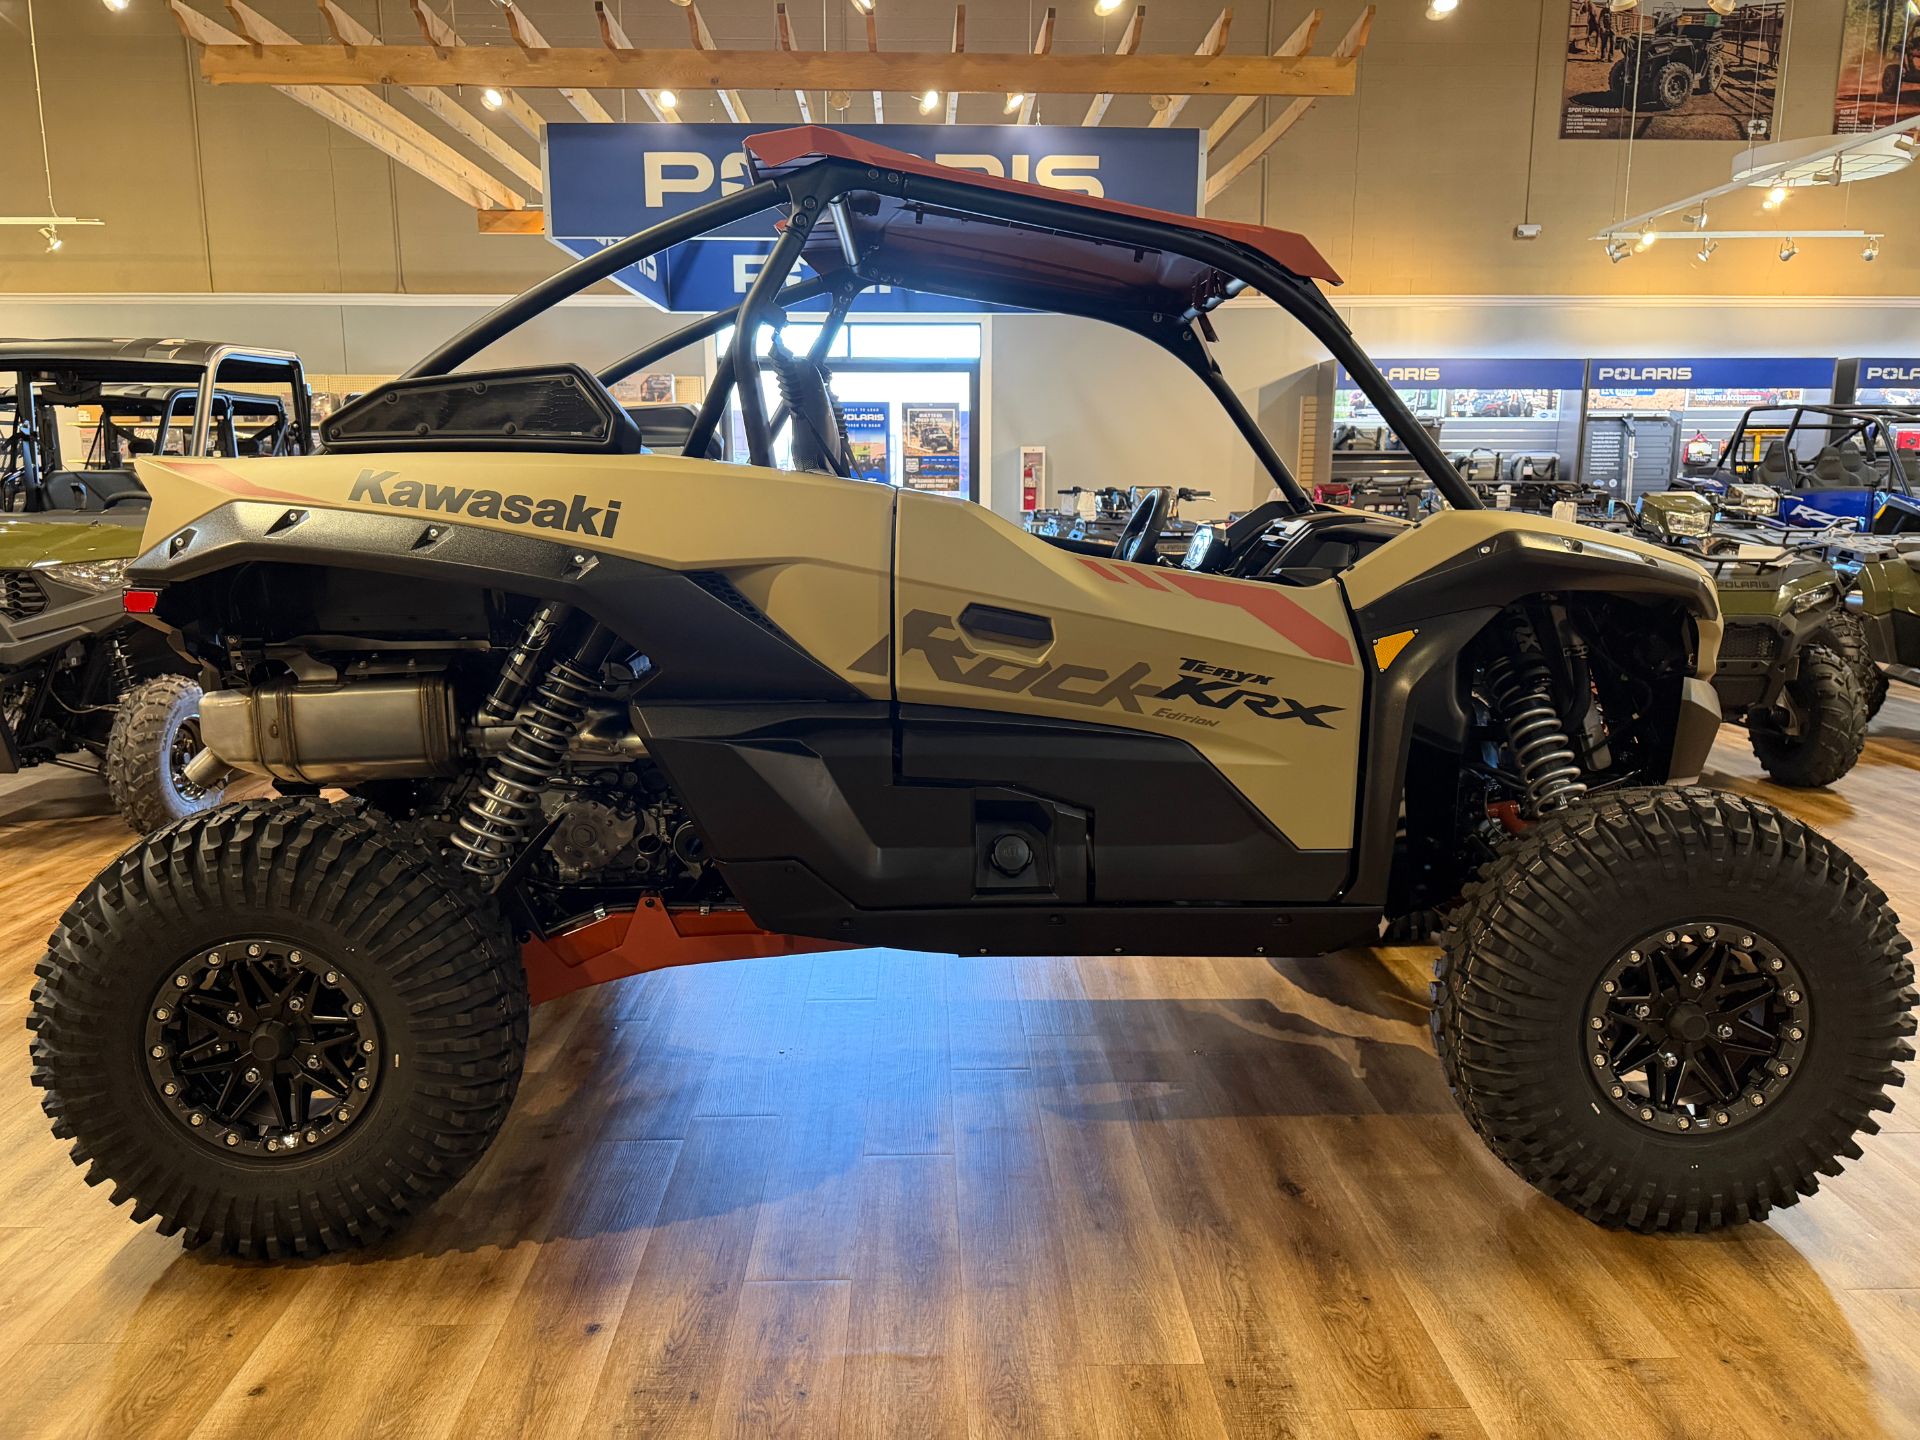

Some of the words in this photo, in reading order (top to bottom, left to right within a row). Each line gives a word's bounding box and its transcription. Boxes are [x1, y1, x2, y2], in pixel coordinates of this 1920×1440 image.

[644, 152, 1104, 207] PRIS
[1345, 367, 1440, 381] ARIS
[1599, 367, 1692, 381] POLARIS
[348, 469, 622, 538] Kawasaki
[1717, 581, 1770, 589] POLARIS
[1153, 674, 1347, 730] KRX
